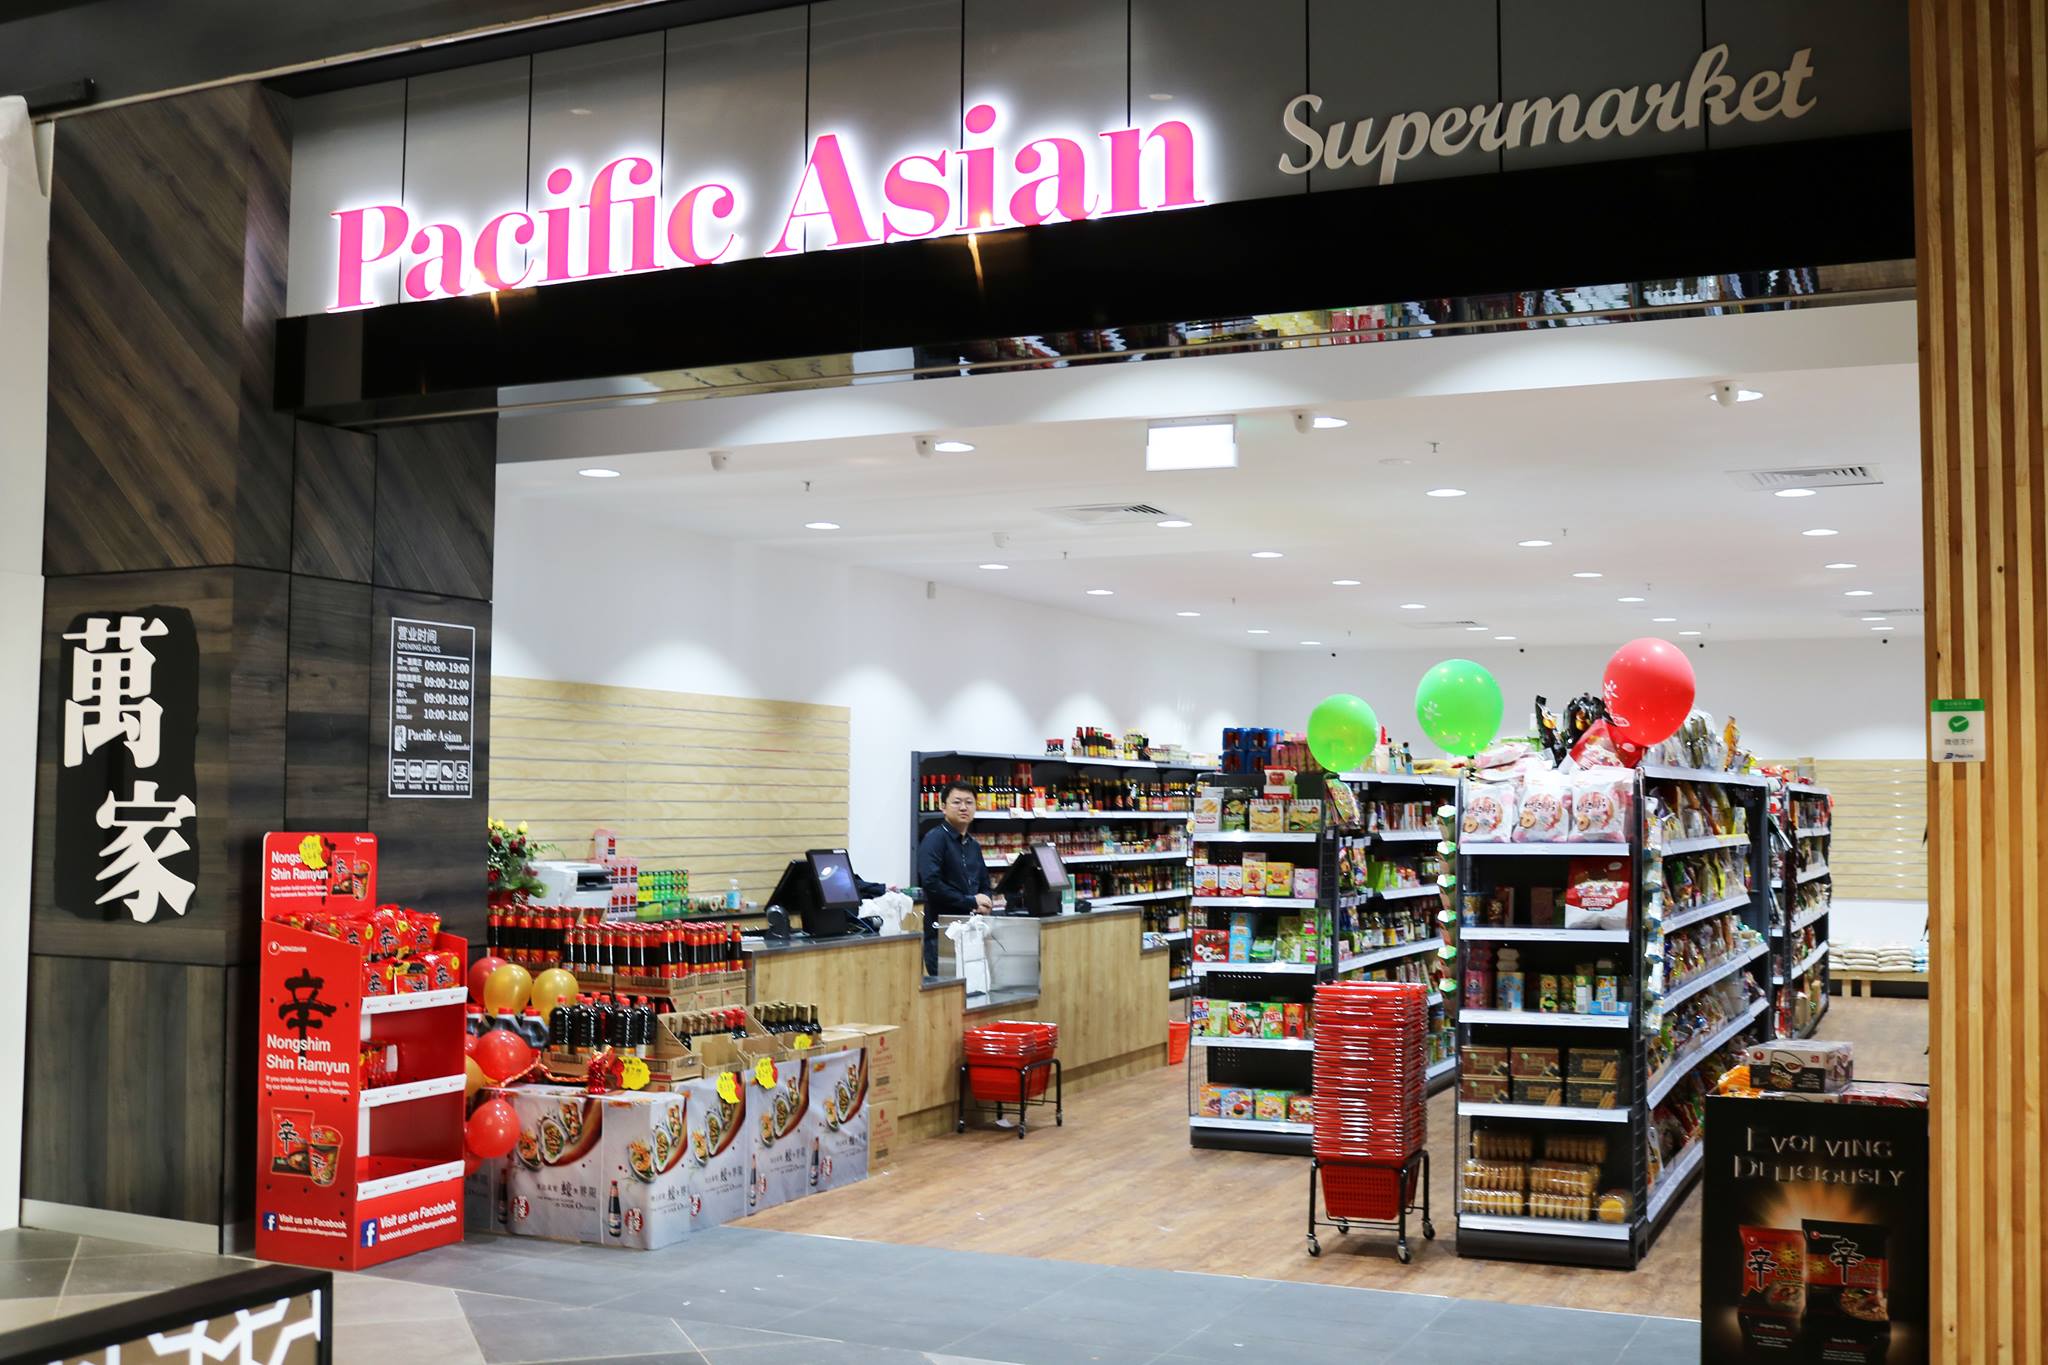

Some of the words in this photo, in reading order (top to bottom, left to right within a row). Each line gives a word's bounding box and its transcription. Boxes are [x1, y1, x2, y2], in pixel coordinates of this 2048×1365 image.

[1279, 43, 1817, 185] Supermarket
[326, 155, 736, 312] Pacific
[763, 103, 1206, 256] Asian
[398, 625, 438, 644] 营业时间
[397, 643, 422, 652] OPENING
[422, 645, 441, 654] HOURS
[424, 660, 470, 675] 09:00-19:00
[423, 676, 470, 691] 09:00-21:00
[423, 692, 469, 707] 09:00-18:00
[423, 708, 469, 722] 10:00-18:00
[407, 728, 437, 742] Pacific
[437, 730, 463, 743] Asian
[62, 615, 197, 924] 萬家
[271, 850, 304, 866] Nongs
[270, 867, 292, 880] Shin
[292, 867, 329, 882] Ramyun
[266, 1033, 331, 1054] Nongshim
[266, 1053, 294, 1070] Shin
[297, 1056, 350, 1076] Ramyun
[279, 1213, 294, 1224] Visit
[294, 1217, 303, 1225] us
[303, 1218, 312, 1226] on
[313, 1216, 347, 1230] Facebook
[380, 1214, 397, 1229] Visit
[397, 1213, 408, 1224] us
[408, 1210, 419, 1222] on
[419, 1199, 457, 1219] Facebook
